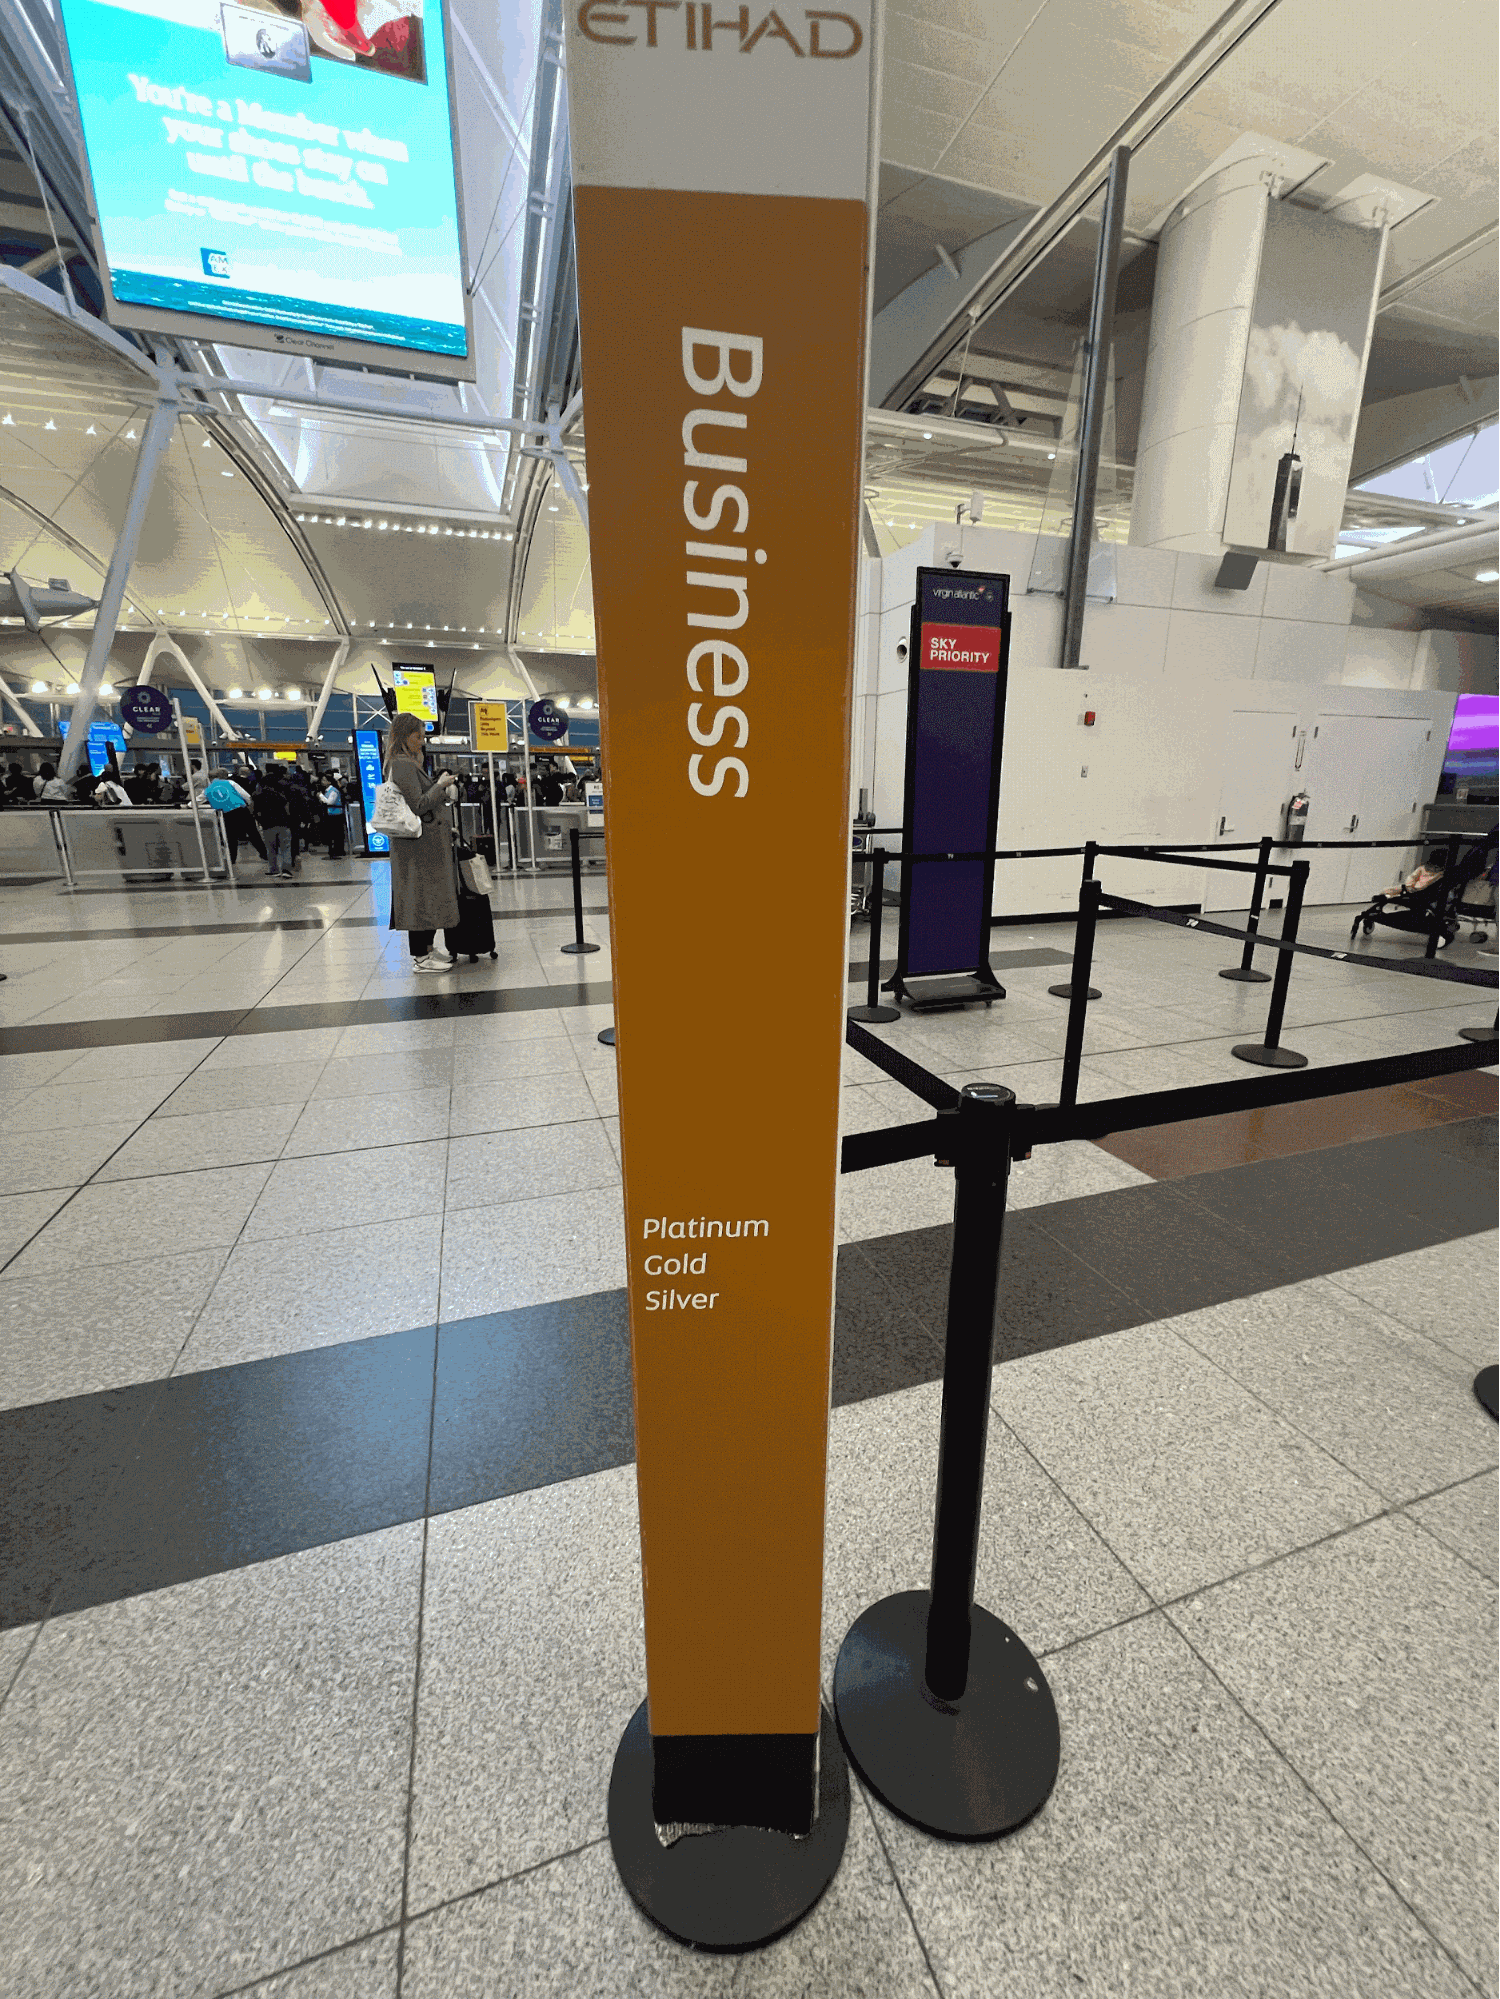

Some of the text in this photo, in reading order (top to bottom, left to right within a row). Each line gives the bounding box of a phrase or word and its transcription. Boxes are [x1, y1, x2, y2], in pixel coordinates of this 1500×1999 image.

[577, 0, 863, 59] ETIHAD
[216, 100, 234, 122] a
[682, 326, 768, 798] Business
[930, 637, 957, 649] SKY
[930, 649, 990, 663] PRIORITY
[643, 1216, 769, 1239] Platinum
[644, 1253, 707, 1275] Gold
[645, 1289, 720, 1311] Silver
